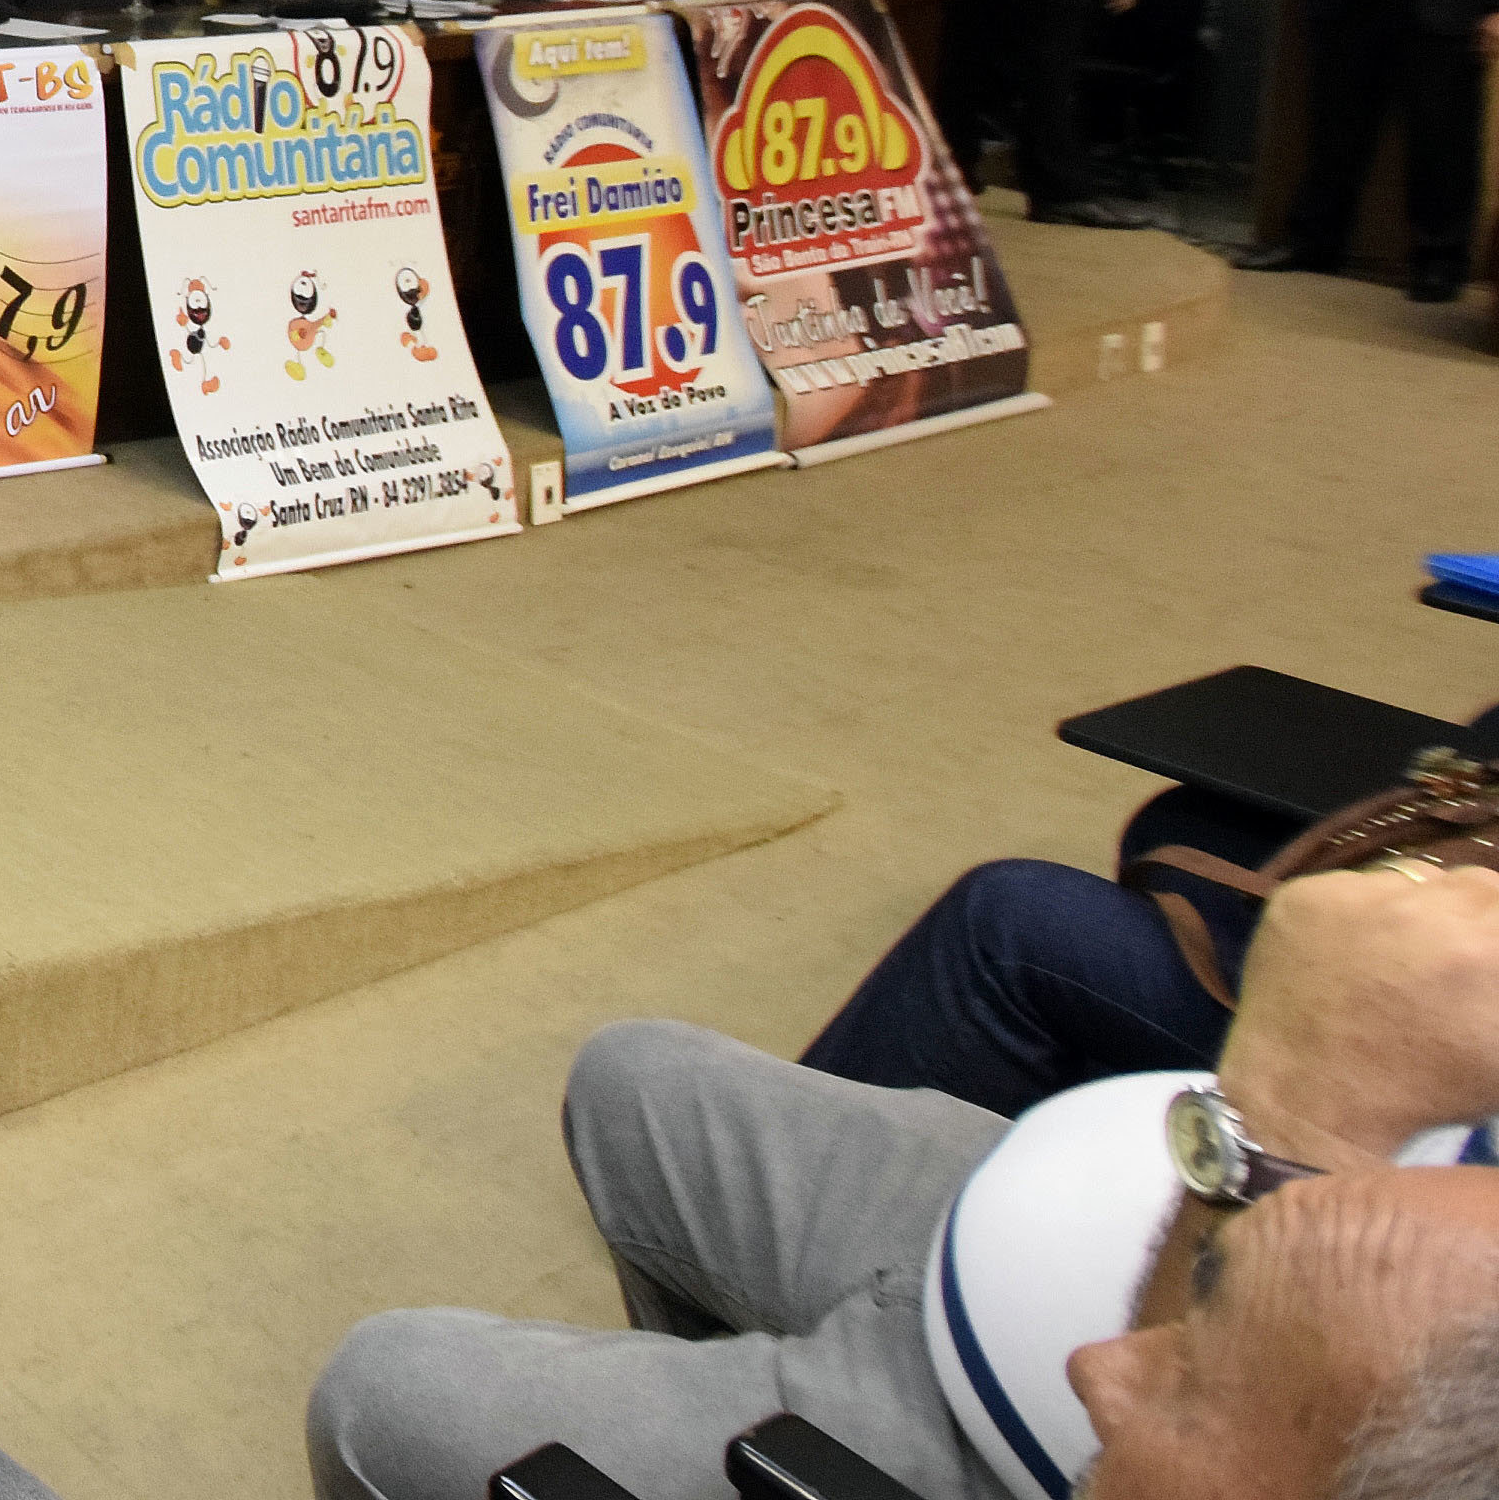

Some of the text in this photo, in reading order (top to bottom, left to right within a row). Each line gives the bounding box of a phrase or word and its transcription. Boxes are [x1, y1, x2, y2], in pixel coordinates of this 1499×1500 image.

[529, 38, 579, 69] Aqui
[159, 56, 300, 134] Rádio
[143, 112, 420, 198] Comunitária
[761, 97, 870, 186] 87.9
[292, 196, 431, 228] santaritafm.com
[527, 168, 684, 222] Frei Damião
[730, 188, 880, 250] Princesa
[547, 244, 717, 381] 87.9
[6, 382, 58, 436] ar
[196, 427, 276, 461] Associação
[276, 417, 320, 449] Rádio
[407, 402, 448, 428] Santa
[609, 402, 622, 421] A
[269, 435, 443, 488] Um Bem da Comunidade
[270, 498, 311, 527] Santa
[315, 492, 345, 520] Cruz
